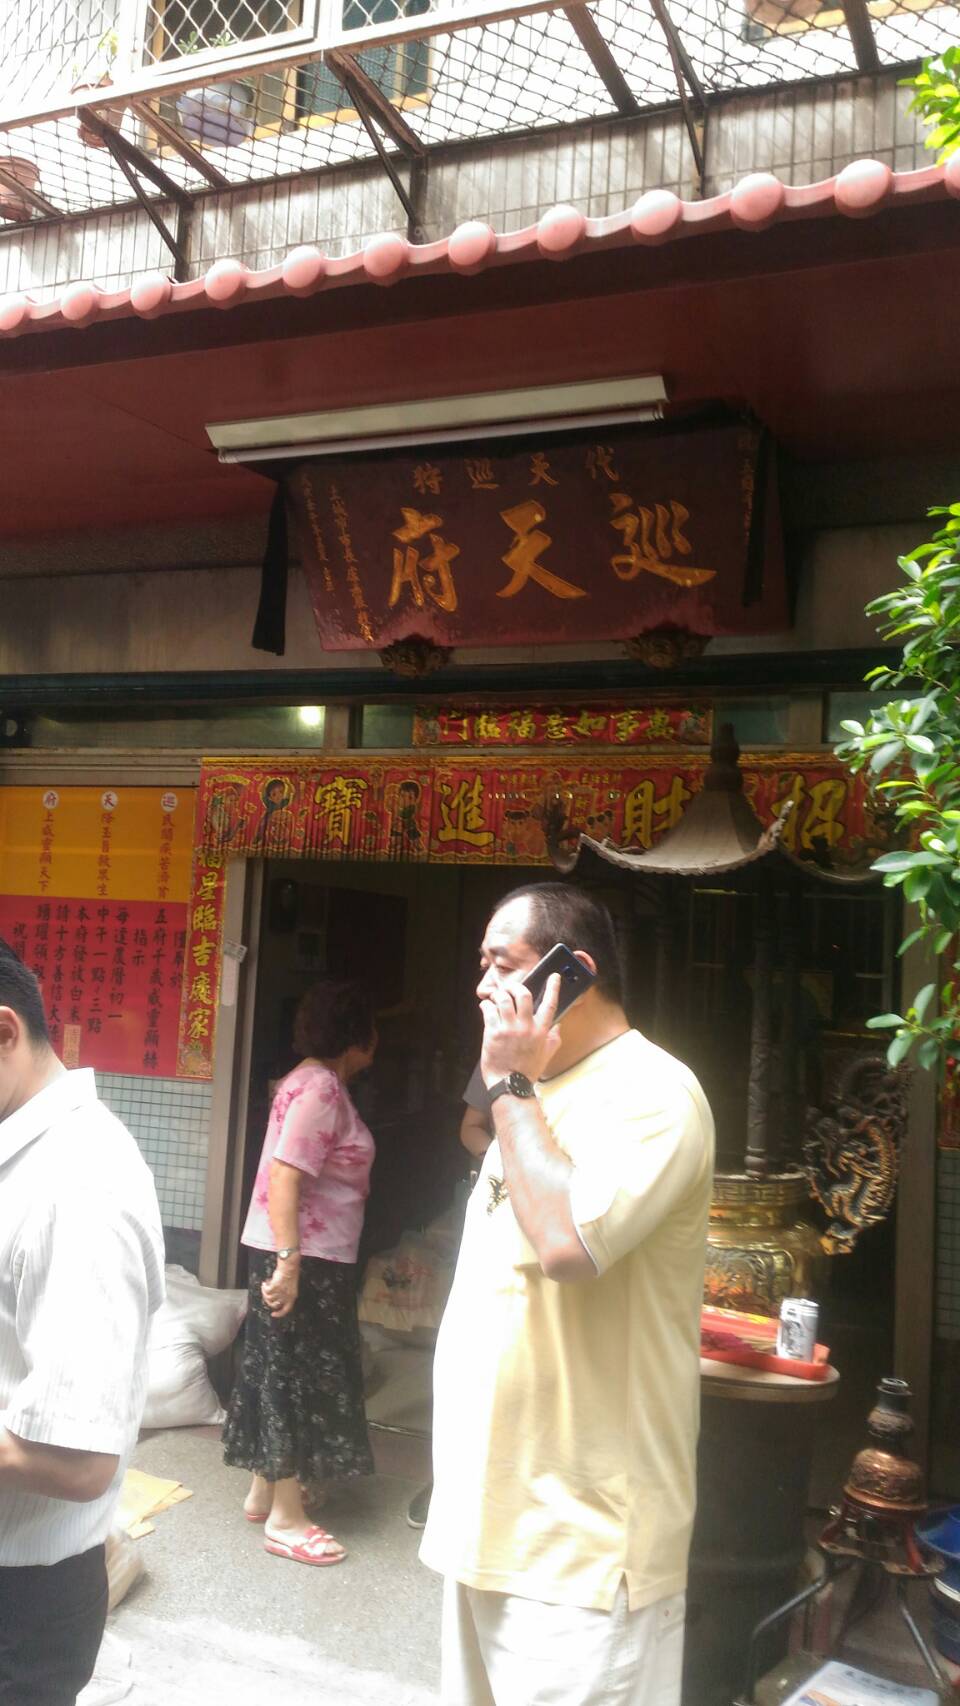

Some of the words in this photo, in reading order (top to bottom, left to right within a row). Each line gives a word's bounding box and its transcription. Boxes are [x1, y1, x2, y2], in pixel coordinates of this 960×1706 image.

[389, 492, 716, 613] 巡天府
[107, 907, 129, 1019] 每逢農曆初一
[132, 927, 148, 967] 指示
